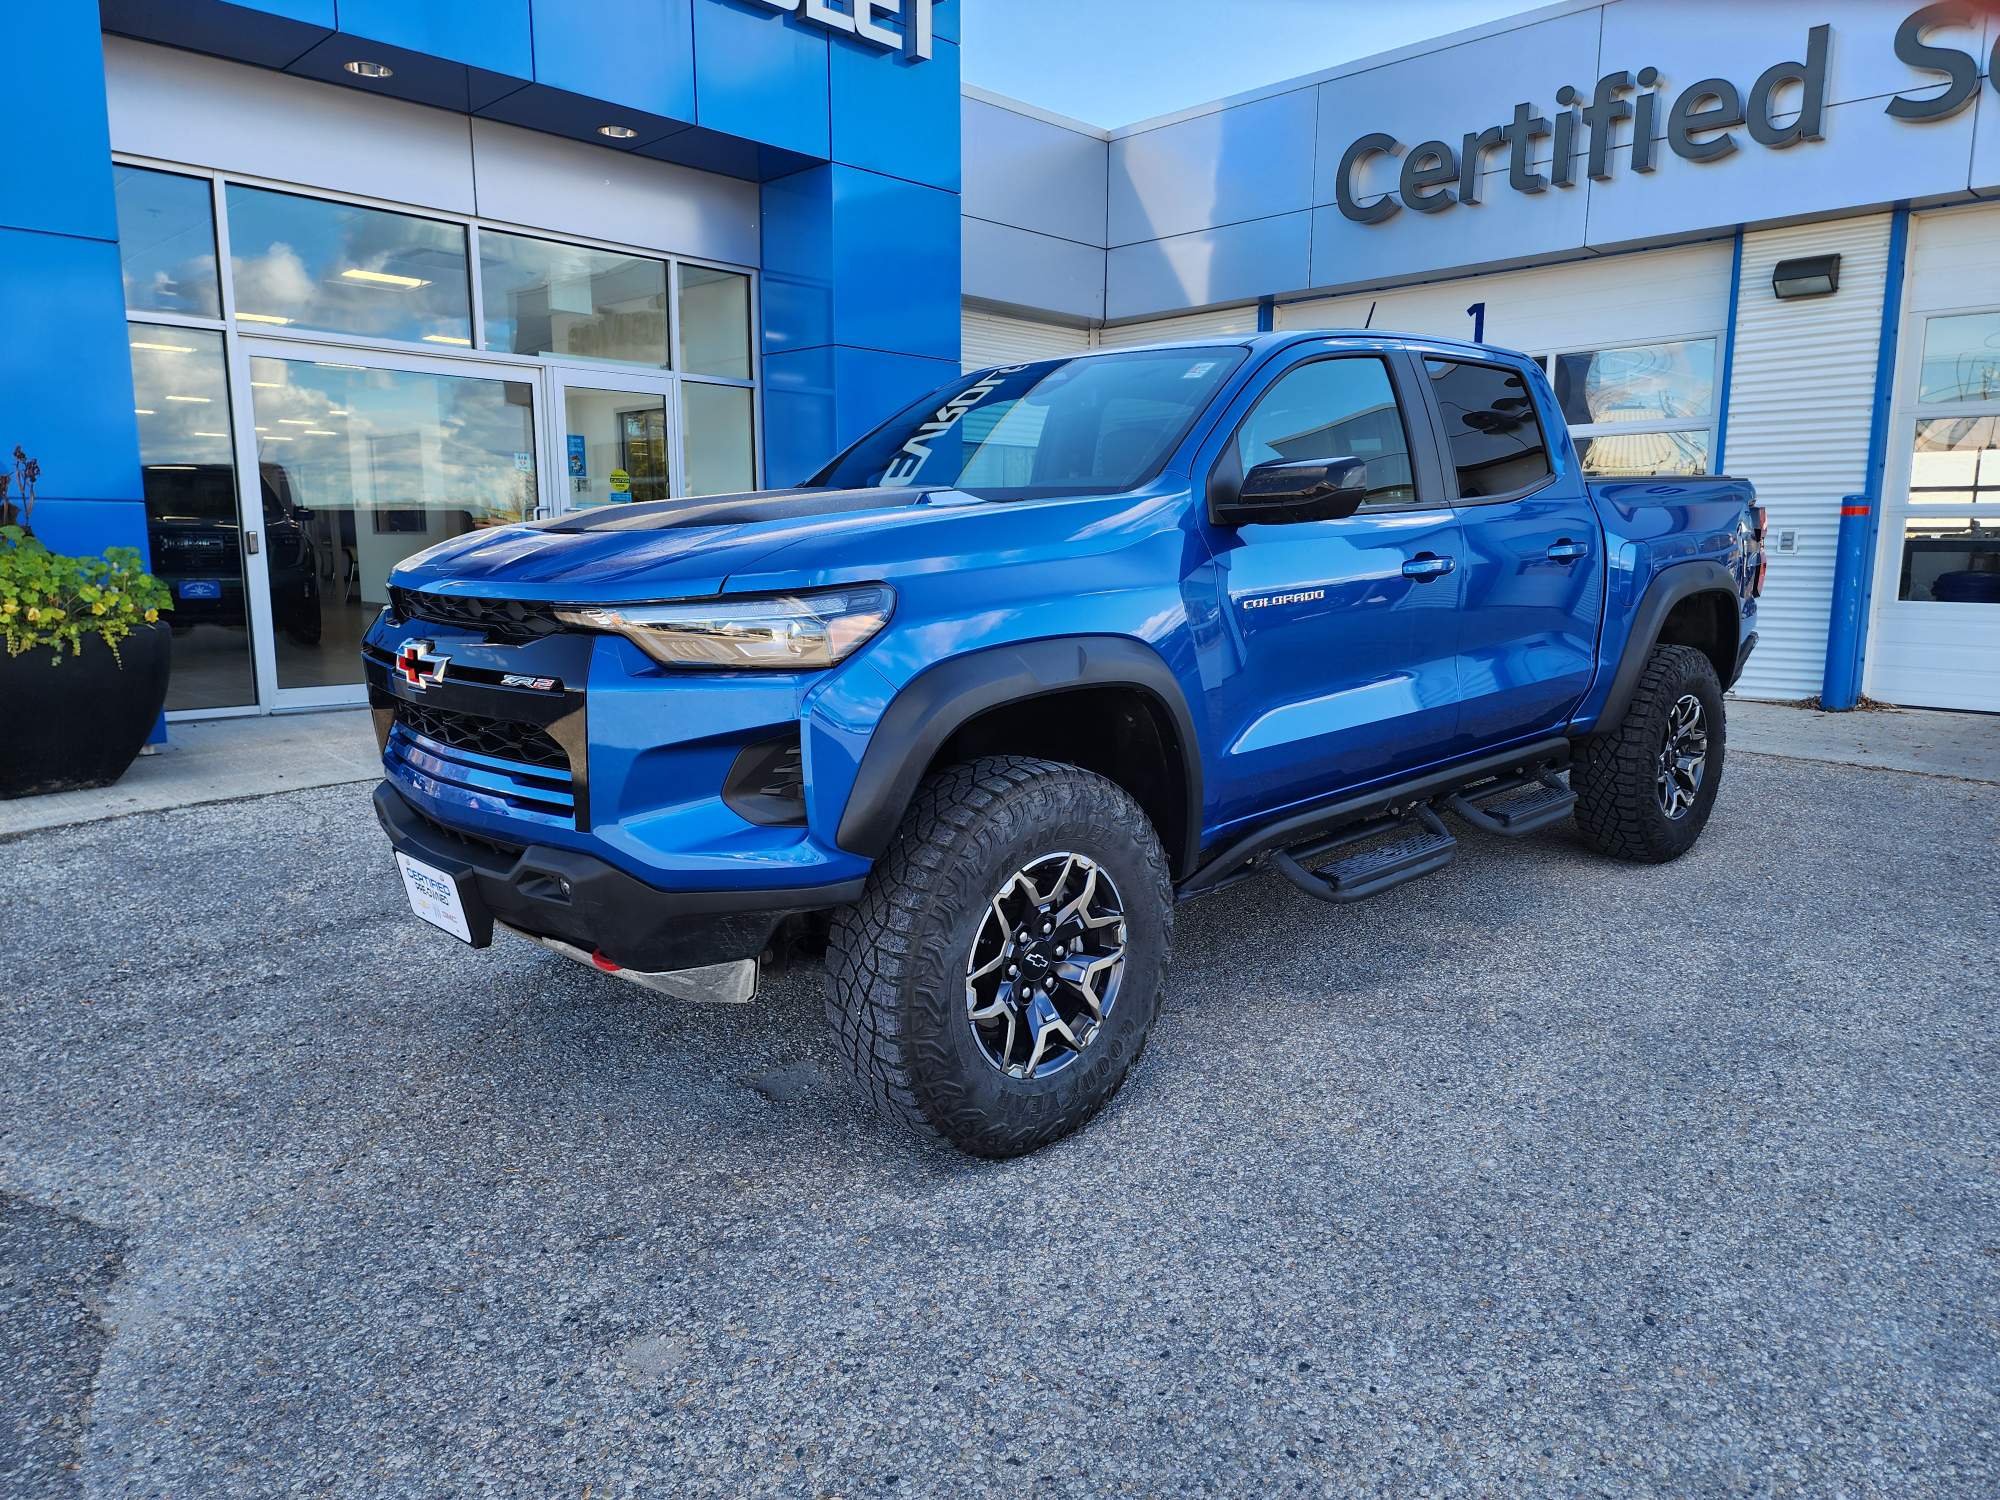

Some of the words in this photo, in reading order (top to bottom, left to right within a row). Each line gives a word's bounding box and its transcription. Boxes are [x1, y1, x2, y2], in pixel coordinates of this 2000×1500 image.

[1336, 23, 1832, 224] Certified
[1884, 0, 2000, 124] S
[1467, 302, 1485, 344] 1
[1243, 590, 1325, 610] COLORADO
